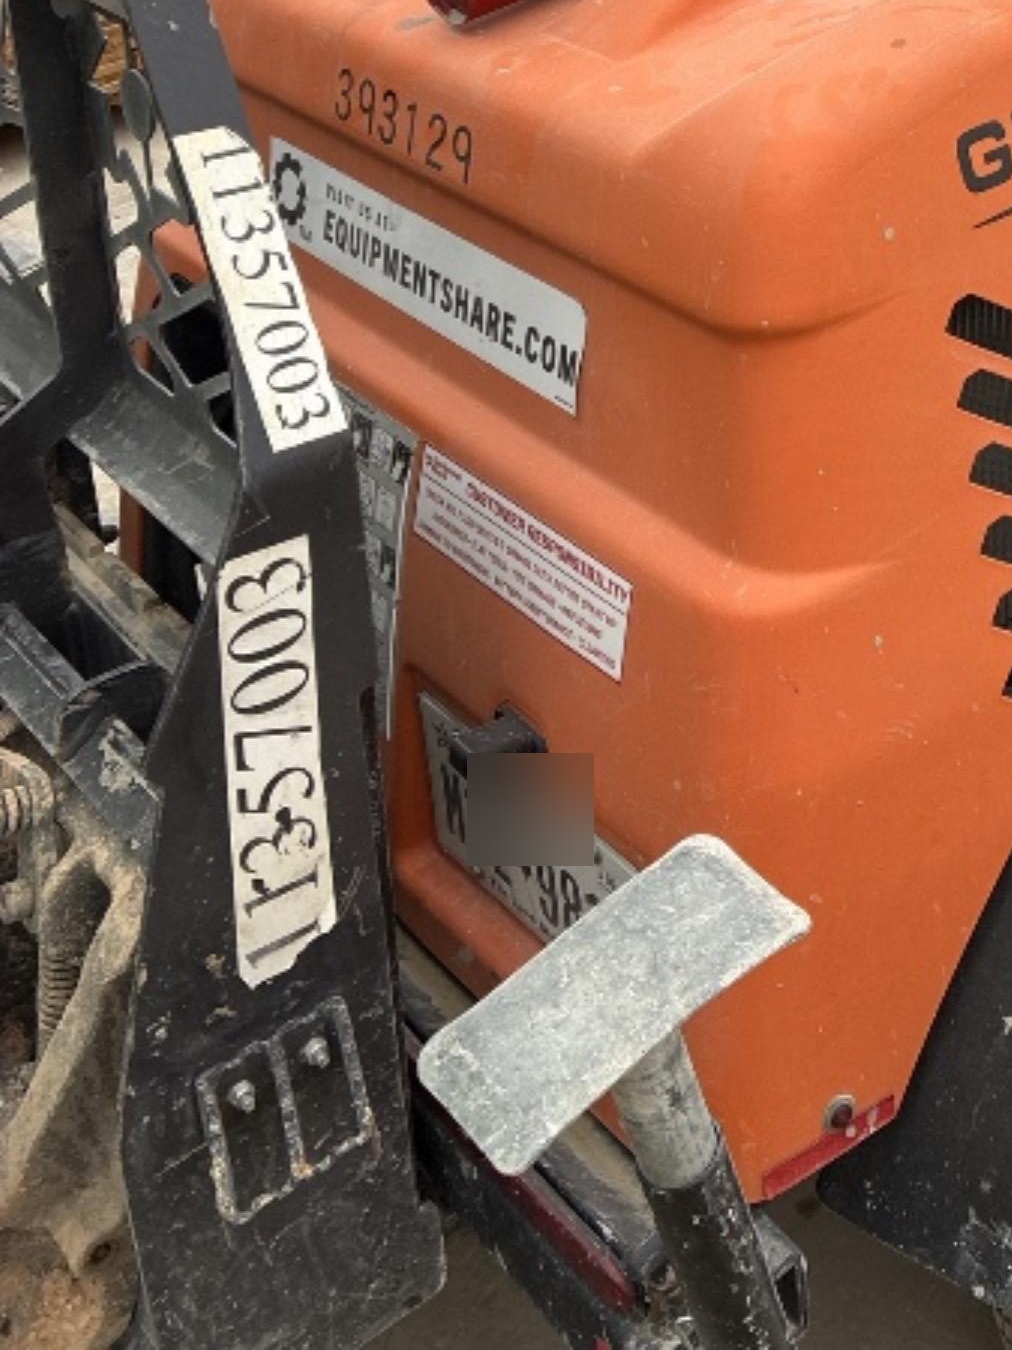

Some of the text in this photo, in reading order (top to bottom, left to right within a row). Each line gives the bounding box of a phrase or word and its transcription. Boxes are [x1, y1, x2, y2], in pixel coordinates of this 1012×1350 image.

[335, 68, 472, 185] 393129
[201, 146, 331, 430] 11357003
[323, 209, 578, 388] EQUIPMENTSHARE.COM
[224, 556, 319, 970] 11357003
